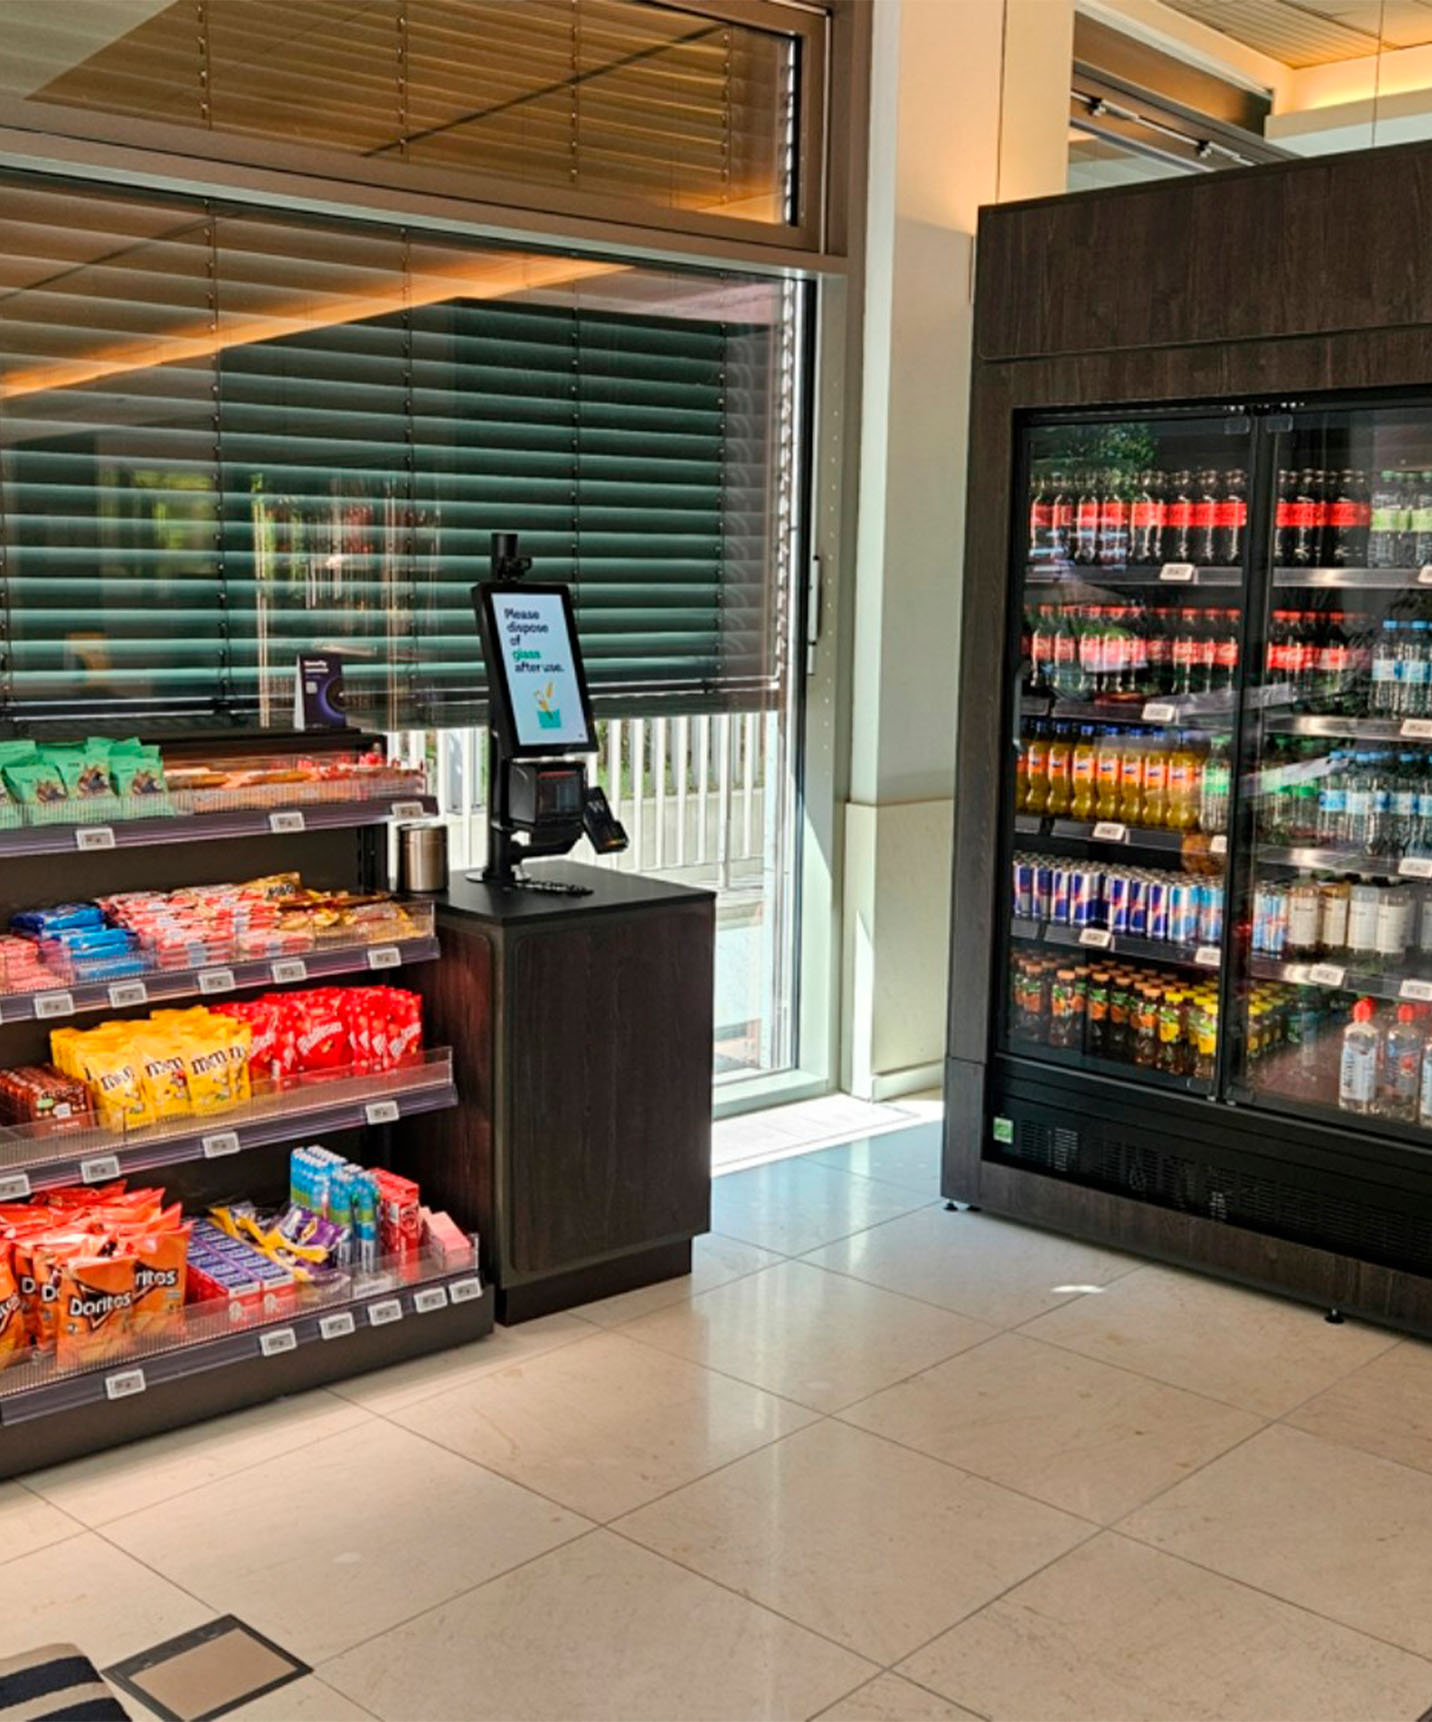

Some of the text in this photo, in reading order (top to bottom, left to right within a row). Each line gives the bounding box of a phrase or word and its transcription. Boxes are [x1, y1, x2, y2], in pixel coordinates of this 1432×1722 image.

[504, 608, 540, 620] Please
[507, 622, 549, 636] dispose
[510, 635, 520, 646] of
[512, 649, 541, 661] glass
[515, 662, 540, 673] after
[136, 1270, 176, 1287] ritos
[69, 1292, 132, 1317] Doritos
